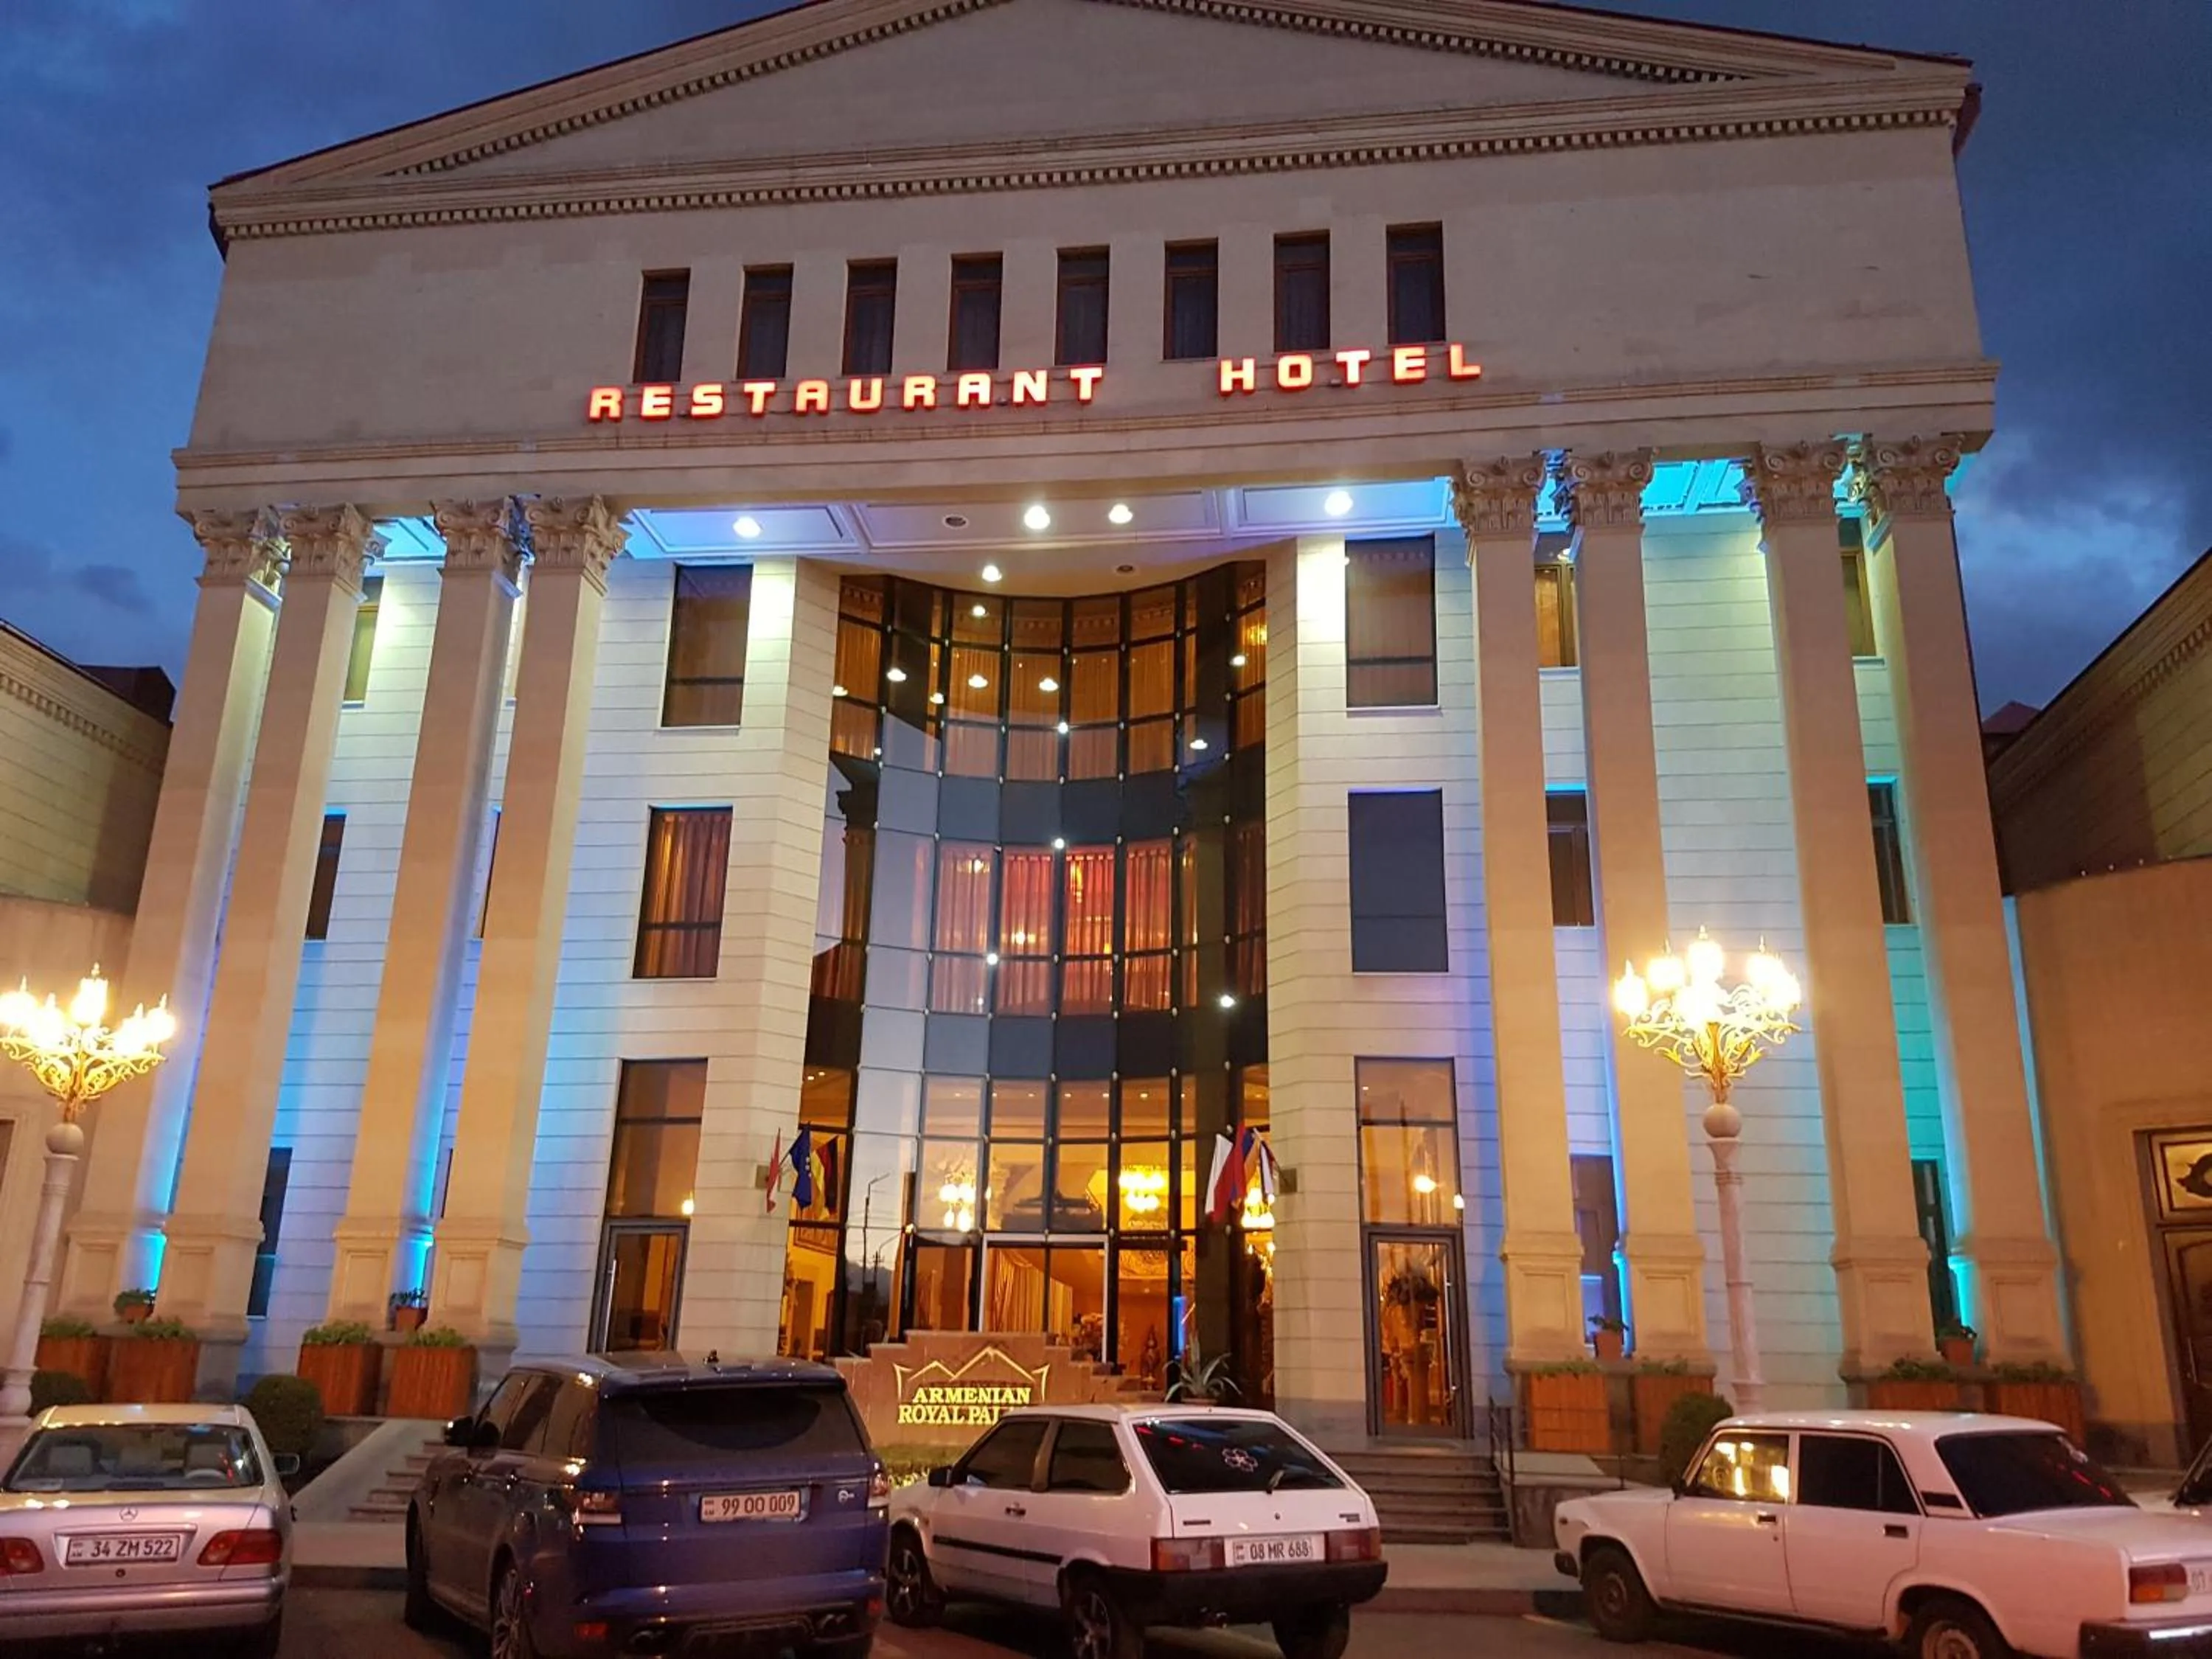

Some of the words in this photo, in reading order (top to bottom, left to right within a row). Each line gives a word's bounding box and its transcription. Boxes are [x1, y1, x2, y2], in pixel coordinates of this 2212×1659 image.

[588, 366, 1105, 420] RESTAURANT
[1217, 344, 1481, 395] HOTEL
[912, 1387, 1031, 1404] ARMENIAN
[897, 1404, 964, 1424] ROYAL
[722, 1498, 740, 1515] 99
[770, 1495, 795, 1512] 009
[91, 1540, 110, 1557] 34
[115, 1540, 139, 1557] ZM
[143, 1540, 173, 1556] 522
[1250, 1543, 1265, 1559] 08
